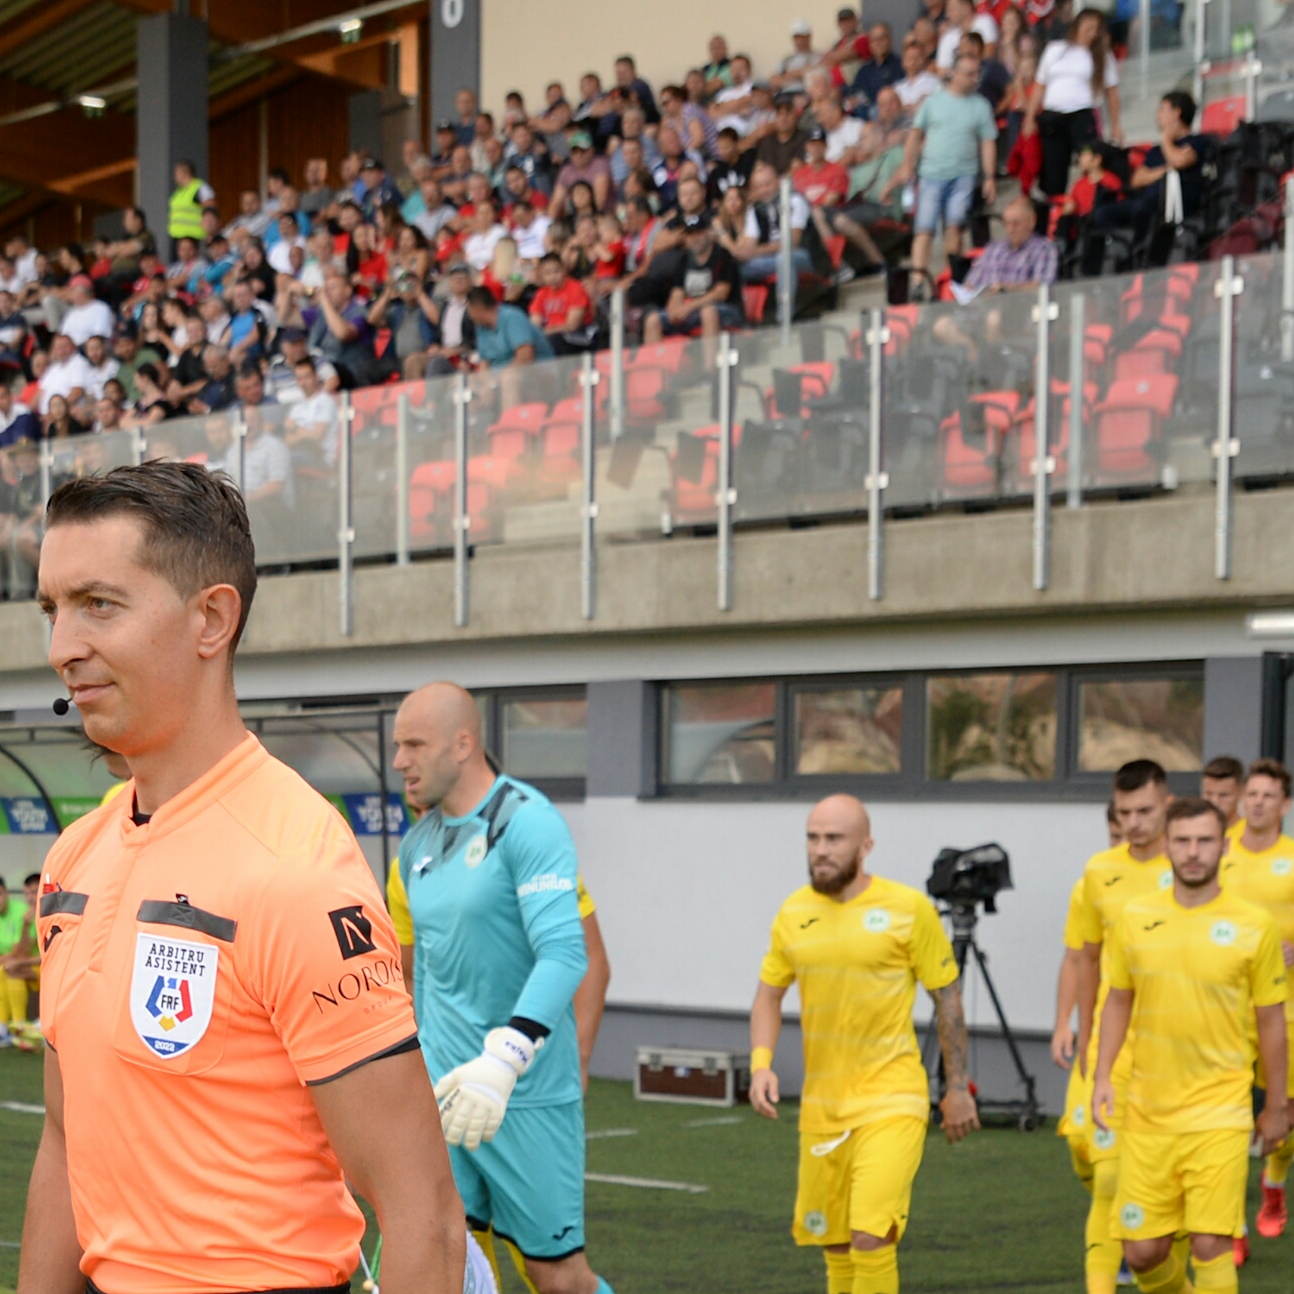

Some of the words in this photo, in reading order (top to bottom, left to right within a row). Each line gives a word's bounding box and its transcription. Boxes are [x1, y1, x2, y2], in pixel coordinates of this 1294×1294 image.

[149, 943, 204, 963] ARBITRU
[145, 956, 205, 976] ASISTENT
[161, 994, 179, 1010] FRF
[154, 1040, 175, 1053] 2022
